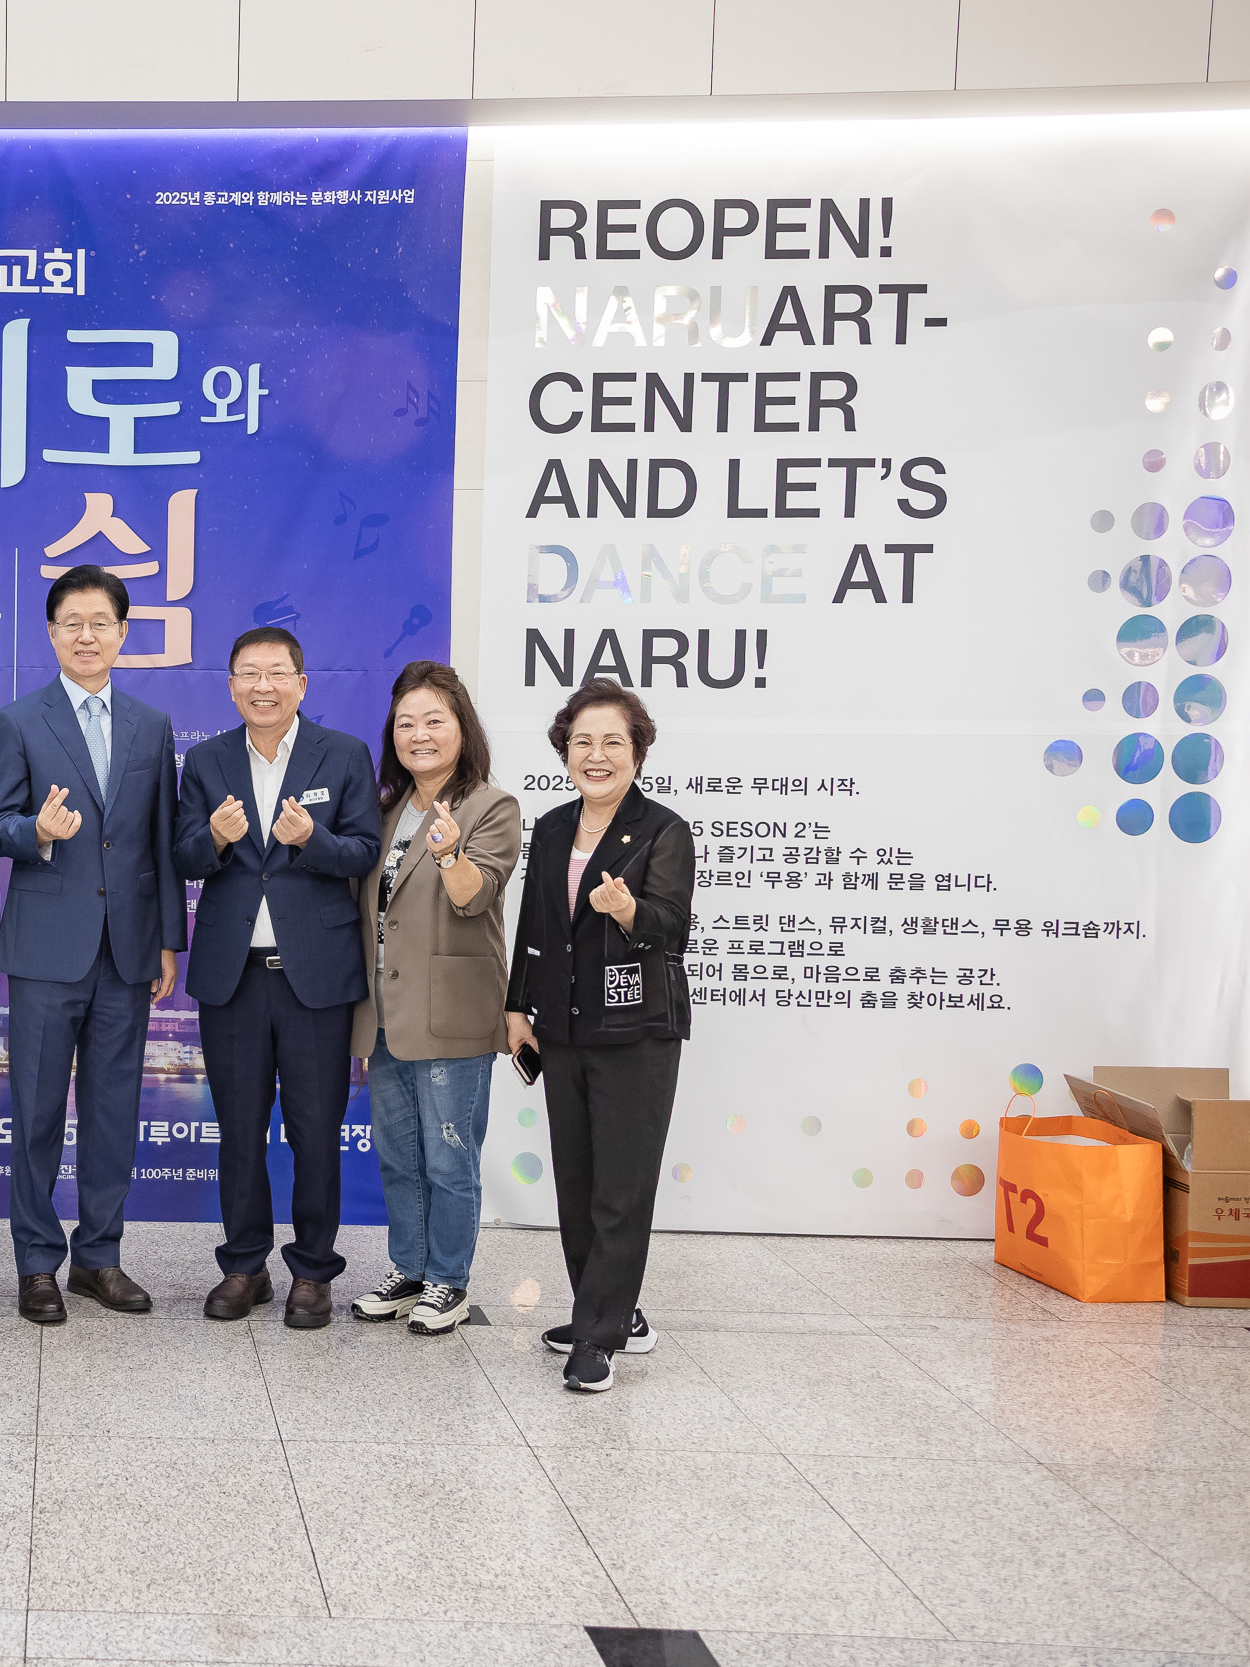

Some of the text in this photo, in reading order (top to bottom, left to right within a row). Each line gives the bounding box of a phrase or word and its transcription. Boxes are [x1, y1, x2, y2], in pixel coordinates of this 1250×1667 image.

[156, 189, 415, 206] 2025년 종교계와 함께하는 문화행사 지원사업
[538, 197, 893, 261] REOPEN!
[528, 371, 858, 434] CENTER
[525, 458, 697, 519] AND
[41, 489, 199, 669] 쉼
[526, 544, 934, 605] DANCE AT
[524, 628, 768, 689] NARU!
[686, 775, 860, 797] 새로운 무대의 시작.
[711, 821, 787, 839] SESON
[717, 845, 775, 864] 즐기고
[783, 846, 842, 865] 공감할
[849, 847, 868, 865] 수
[876, 847, 913, 866] 있는
[696, 869, 997, 892] 장르인 과 함께 문을 엽니다.
[711, 913, 770, 933] 스트릿
[779, 914, 822, 935] 댄스,
[829, 915, 893, 936] 뮤지컬,
[901, 916, 985, 937] 생활댄스,
[992, 918, 1033, 938] 무용
[1041, 918, 1146, 940] 워크숍까지.
[726, 939, 845, 958] 프로그램으로
[731, 963, 1001, 987] 몸으로, 마음으로 춤추는 공간.
[774, 988, 1011, 1011] 당신만의 춤을 찾아보세요.
[140, 1167, 183, 1181] 100주년
[999, 1176, 1049, 1248] T2
